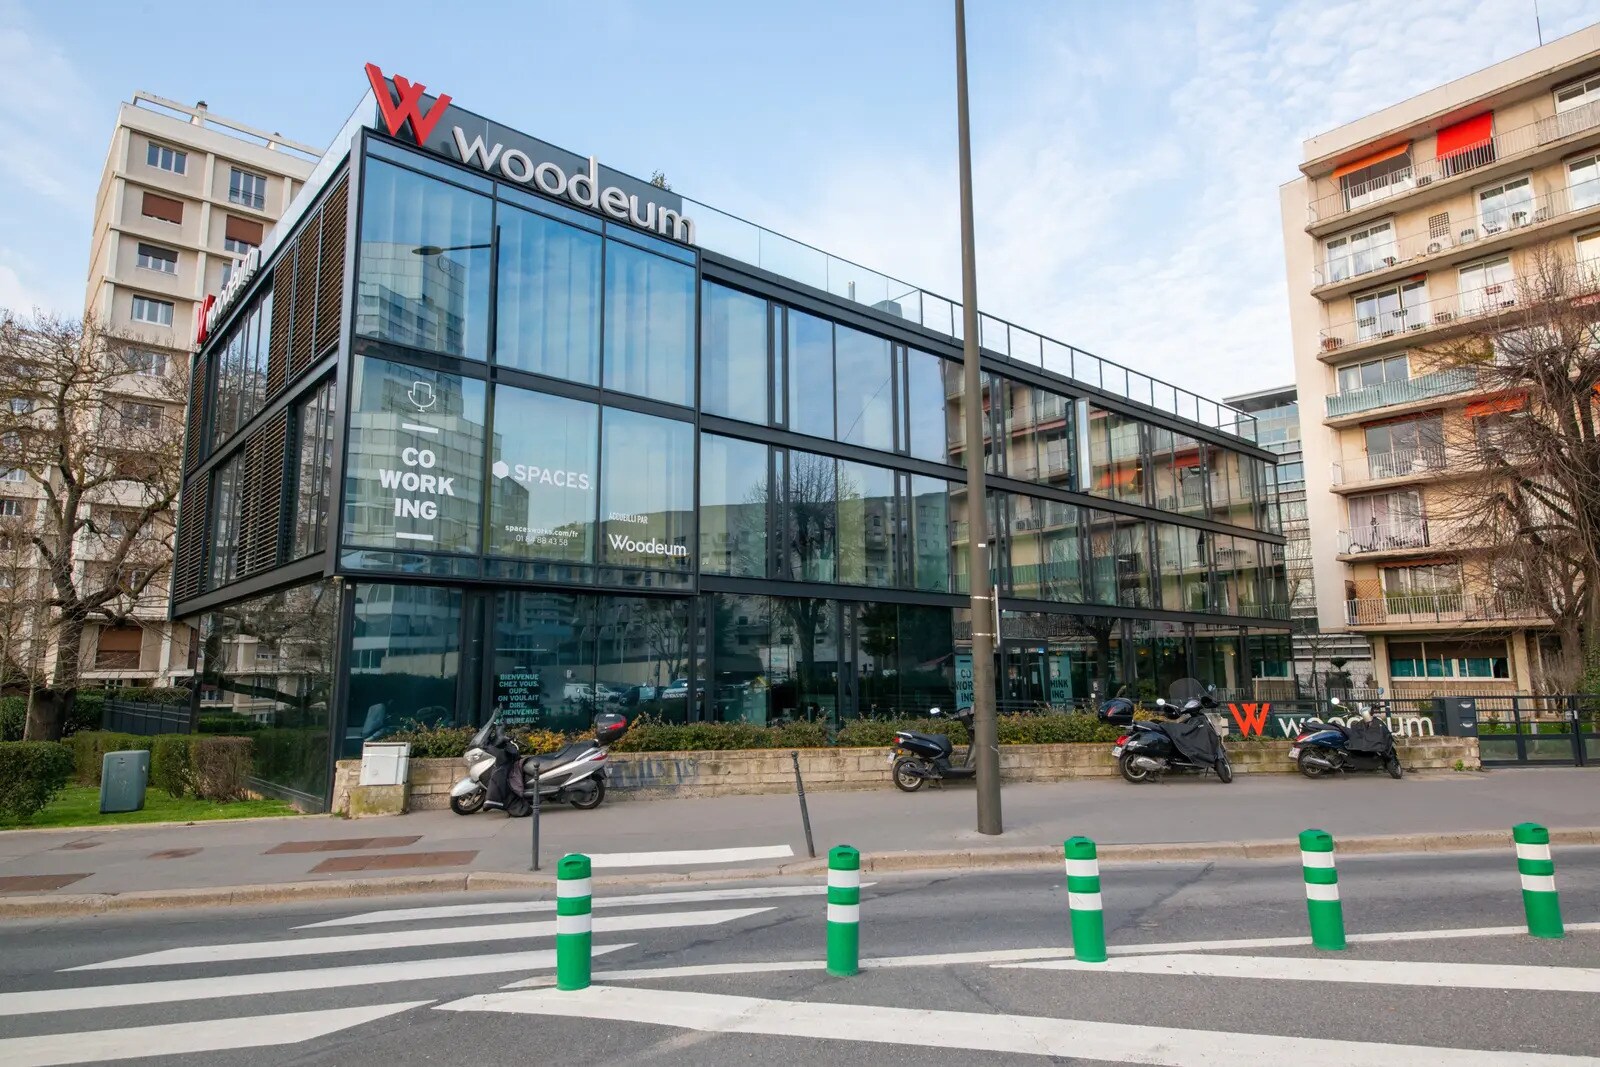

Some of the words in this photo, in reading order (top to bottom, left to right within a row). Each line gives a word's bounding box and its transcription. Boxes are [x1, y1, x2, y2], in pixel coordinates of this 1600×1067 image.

[452, 125, 696, 245] woodeum
[401, 447, 436, 469] CO
[379, 468, 455, 496] WORK
[394, 498, 438, 520] ING
[637, 515, 648, 524] PAR
[505, 525, 579, 538] spacesworks.com/fr
[516, 534, 524, 542] 01
[608, 533, 687, 557] Woodeum
[1049, 679, 1069, 688] HINK
[1051, 689, 1065, 699] ING
